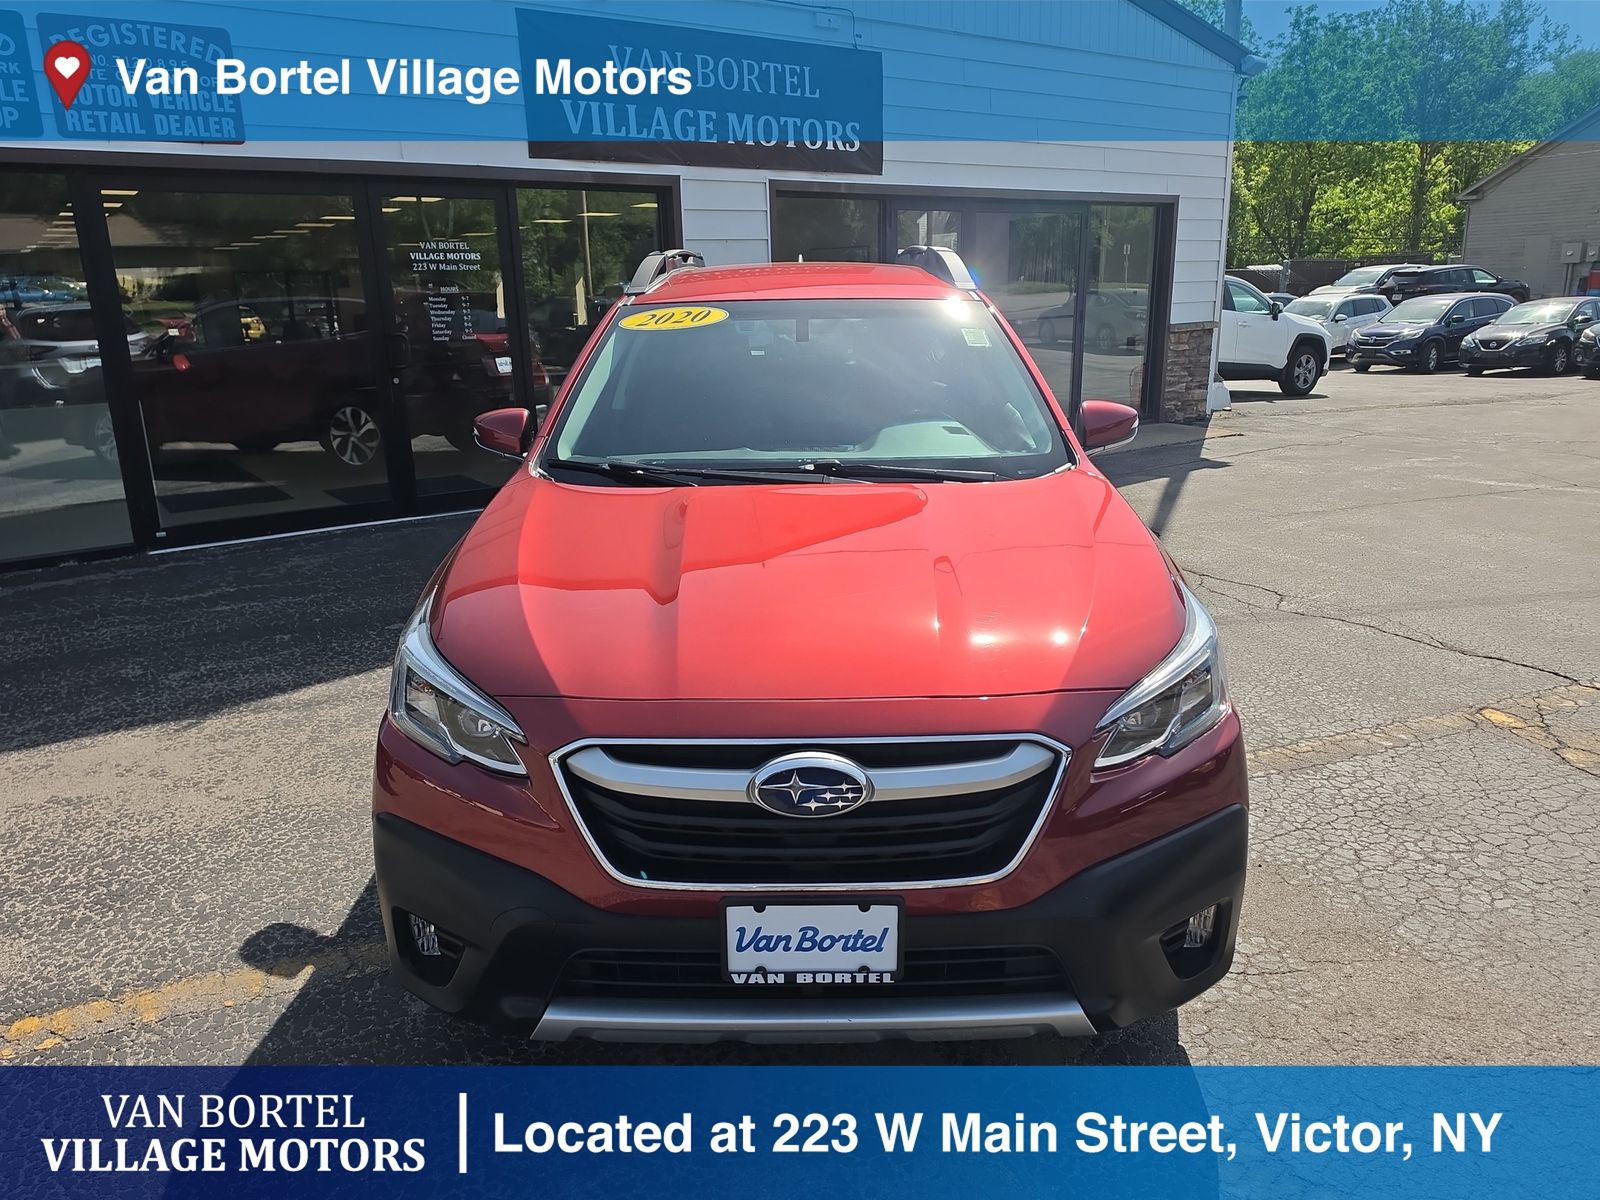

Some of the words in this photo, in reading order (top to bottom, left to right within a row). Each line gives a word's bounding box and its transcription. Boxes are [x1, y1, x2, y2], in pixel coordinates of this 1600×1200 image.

[608, 45, 685, 86] VAN
[695, 54, 820, 98] BORTEL
[65, 109, 146, 135] RETAIL
[154, 114, 236, 139] DEALER
[560, 99, 718, 144] VILLAGE
[726, 112, 861, 152] MOTORS
[420, 241, 437, 250] VAN
[438, 241, 470, 250] BORTEL
[409, 252, 445, 261] VILLAGE
[446, 252, 481, 261] MOTORS
[412, 262, 428, 271] 223
[428, 263, 438, 271] W
[439, 262, 458, 271] Main
[458, 262, 481, 271] Street
[635, 309, 711, 327] 2020
[735, 926, 793, 953] Van
[794, 926, 890, 953] Bortel
[730, 973, 785, 984] VAN
[796, 973, 895, 984] BORTEL
